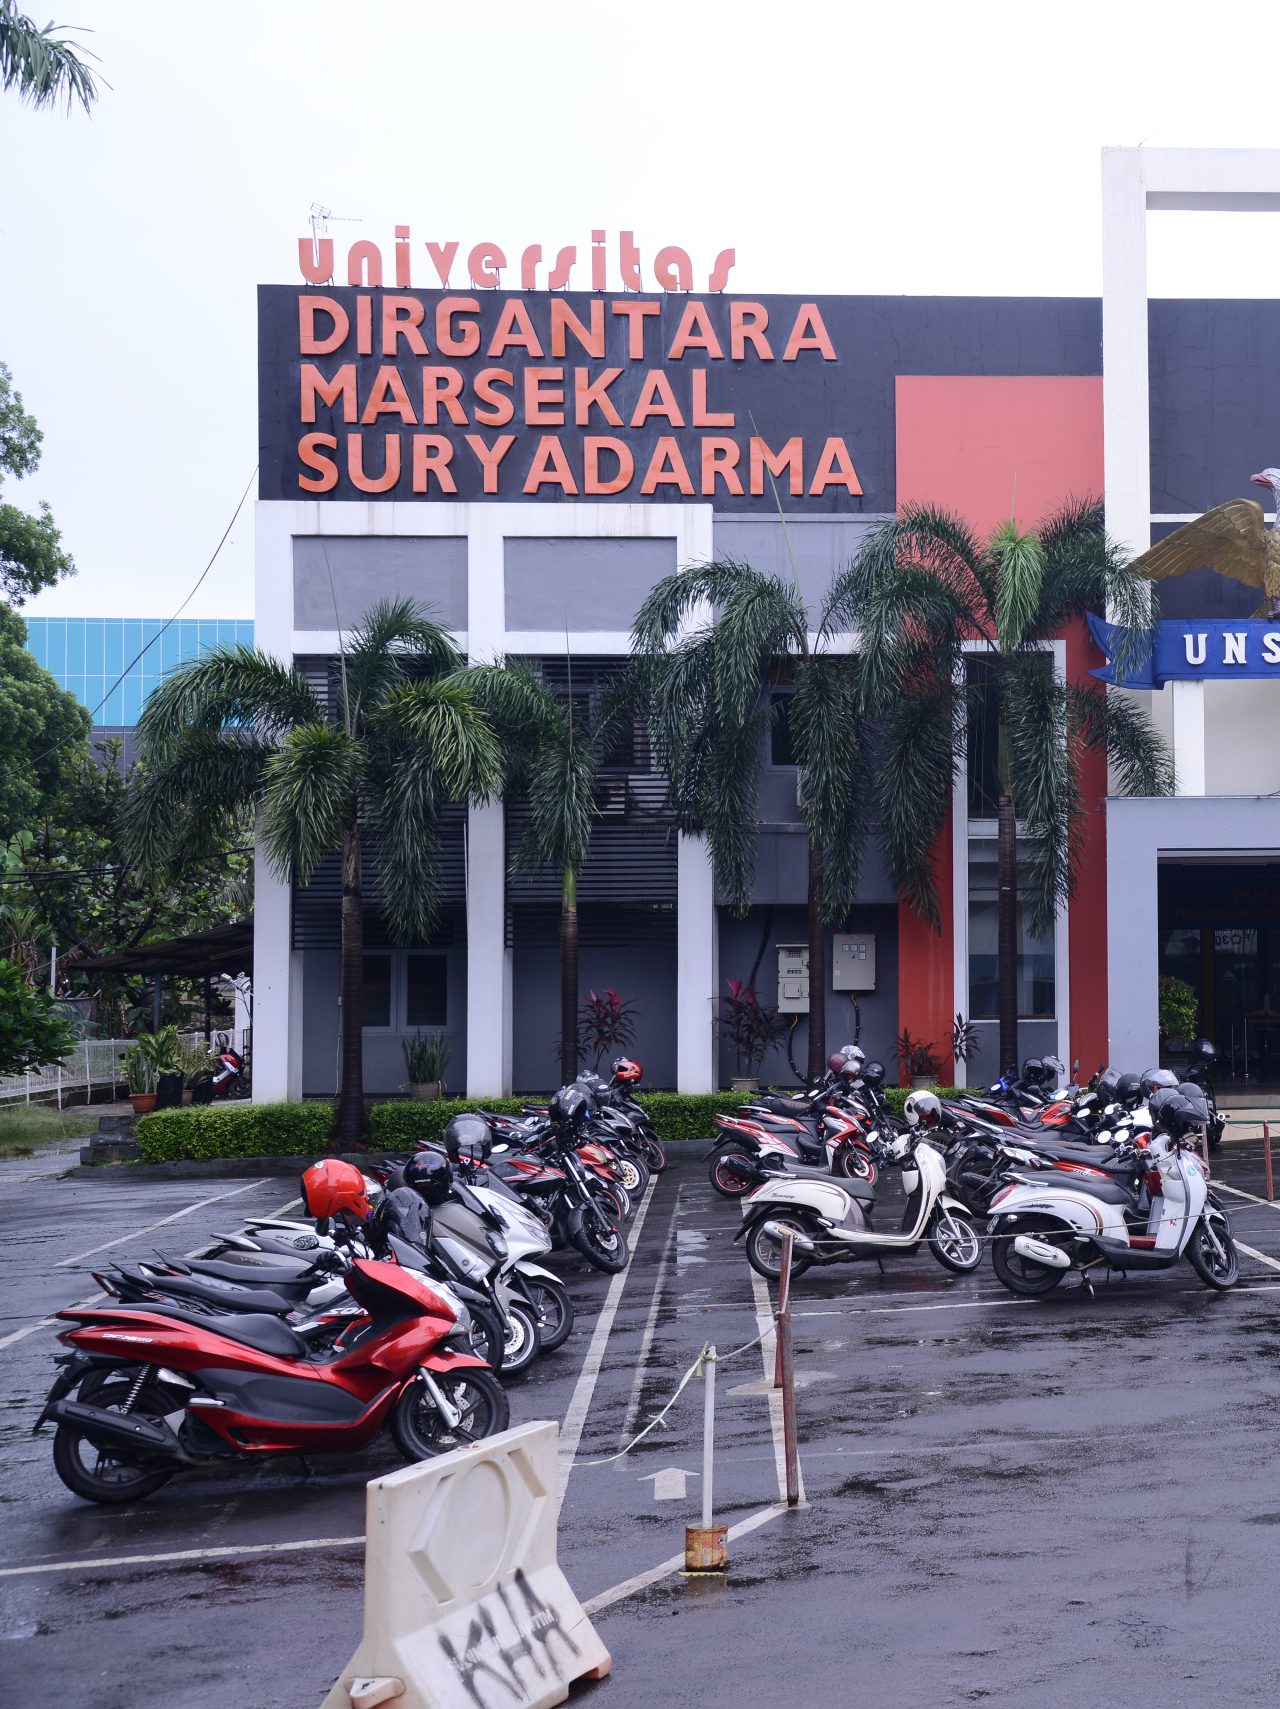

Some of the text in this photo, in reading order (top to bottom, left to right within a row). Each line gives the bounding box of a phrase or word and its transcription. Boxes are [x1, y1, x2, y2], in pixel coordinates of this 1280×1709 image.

[299, 225, 735, 291] universitas
[299, 295, 838, 361] DIRGANTARA
[300, 364, 735, 427] MARSEKAL
[298, 433, 864, 497] SURYADARMA
